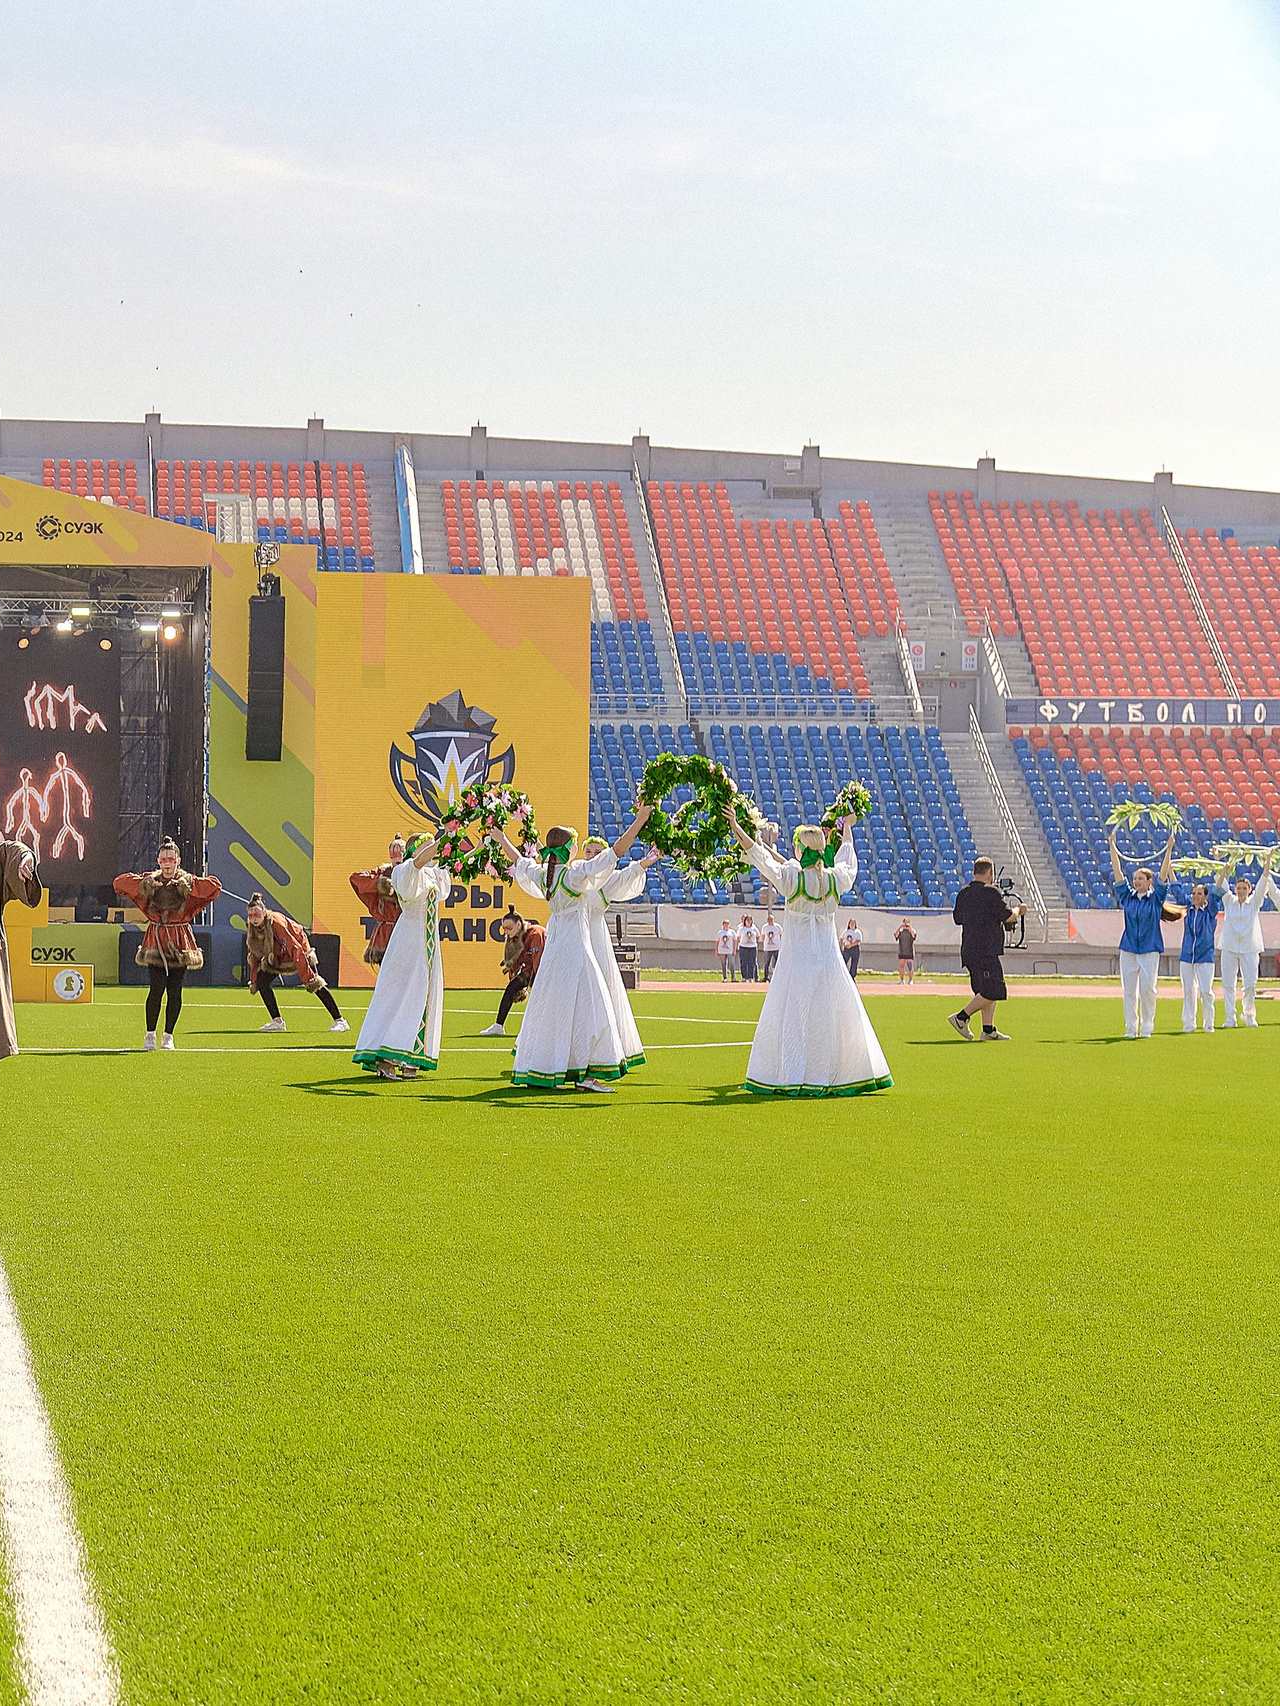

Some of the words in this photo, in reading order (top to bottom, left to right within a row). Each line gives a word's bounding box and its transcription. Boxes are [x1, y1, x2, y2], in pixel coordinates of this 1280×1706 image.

[64, 521, 104, 535] СУЭК
[1039, 699, 1196, 723] ФУТБОЛ
[1226, 703, 1267, 723] ПО
[31, 947, 76, 961] СУЭК
